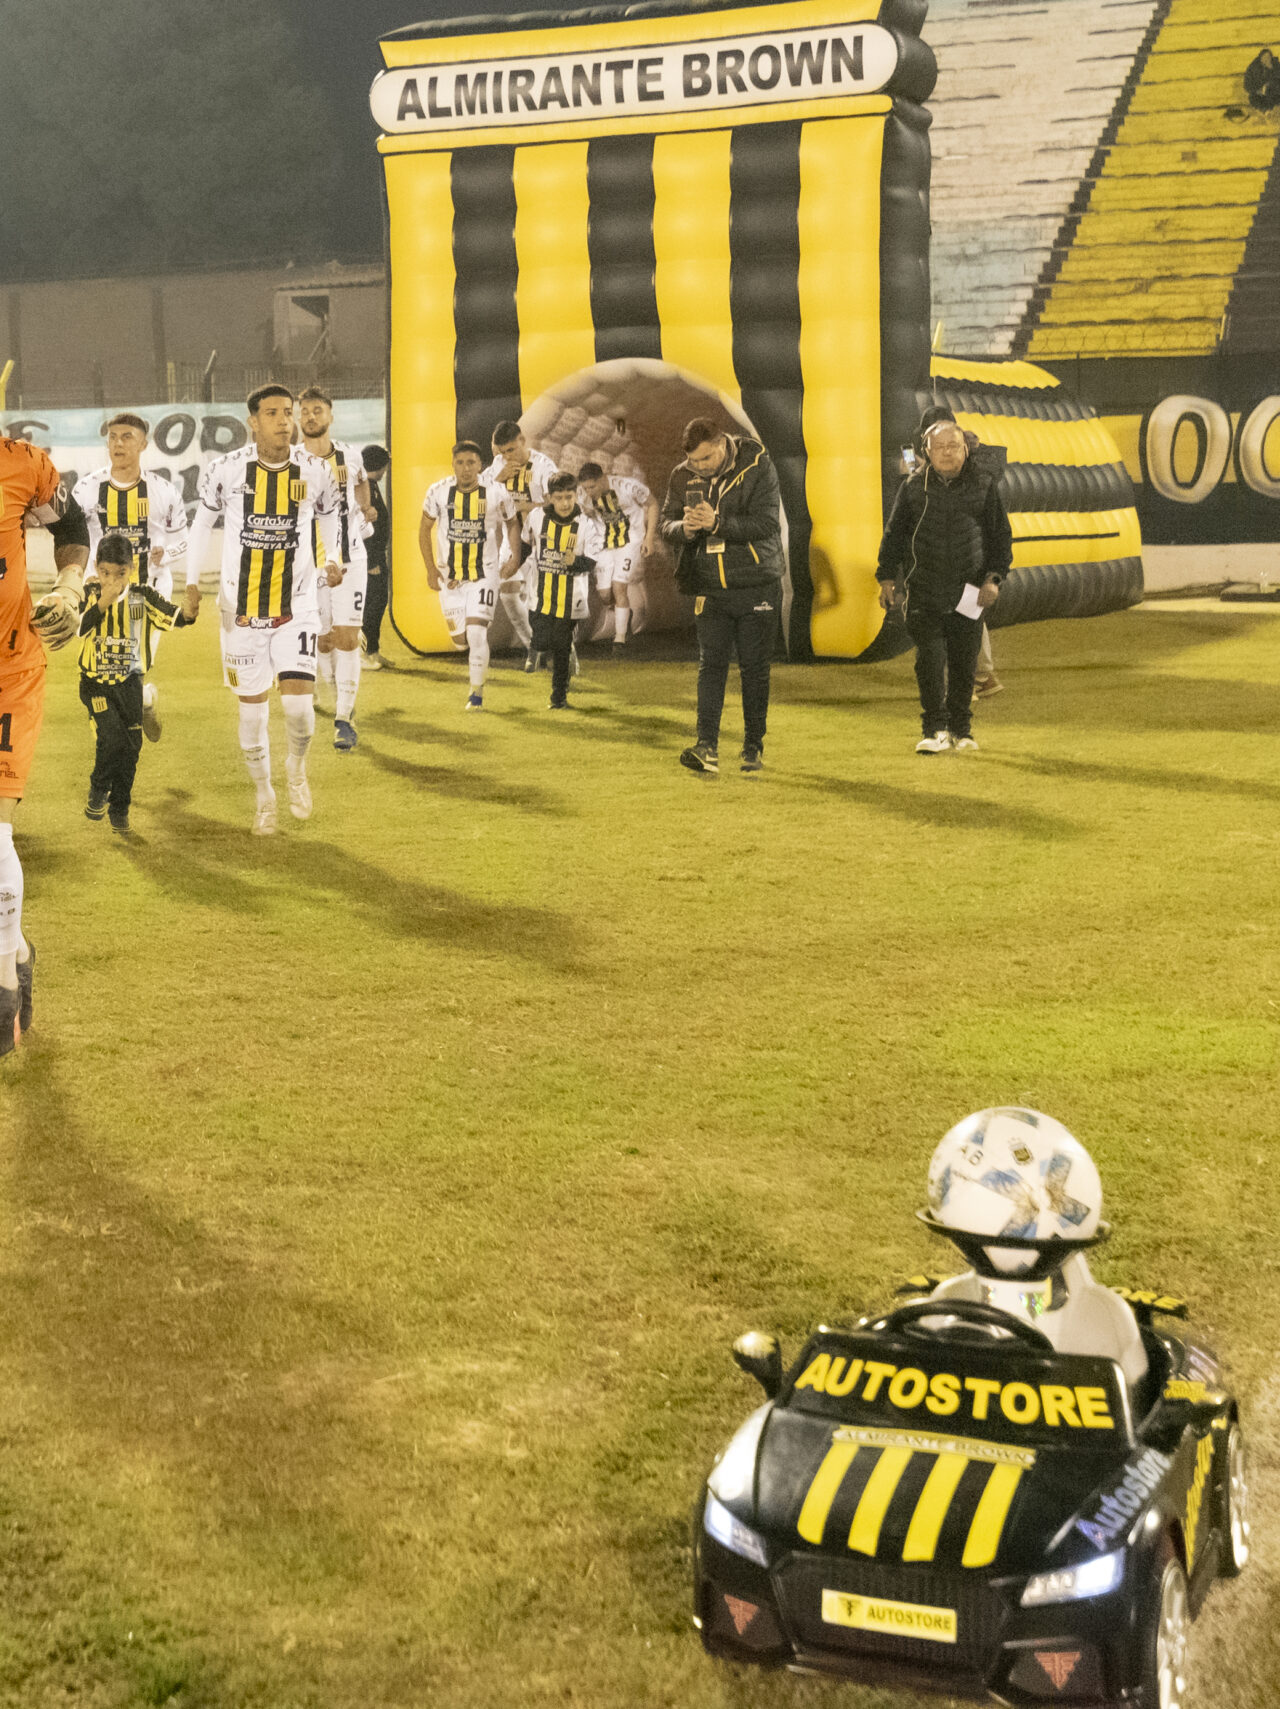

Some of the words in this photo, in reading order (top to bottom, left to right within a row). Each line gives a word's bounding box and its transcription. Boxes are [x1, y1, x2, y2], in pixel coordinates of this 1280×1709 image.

[396, 57, 665, 121] ALMIRANTE
[681, 34, 865, 98] BROWN
[247, 514, 294, 527] CartaSur
[240, 539, 283, 550] POMPEYA
[241, 531, 288, 542] MERCEDES
[622, 558, 632, 572] 3
[353, 591, 363, 611] 2
[478, 588, 495, 607] 10
[297, 631, 317, 658] 11
[795, 1352, 1115, 1430] AUTOSTORE
[866, 1604, 952, 1632] AUTOSTORE
